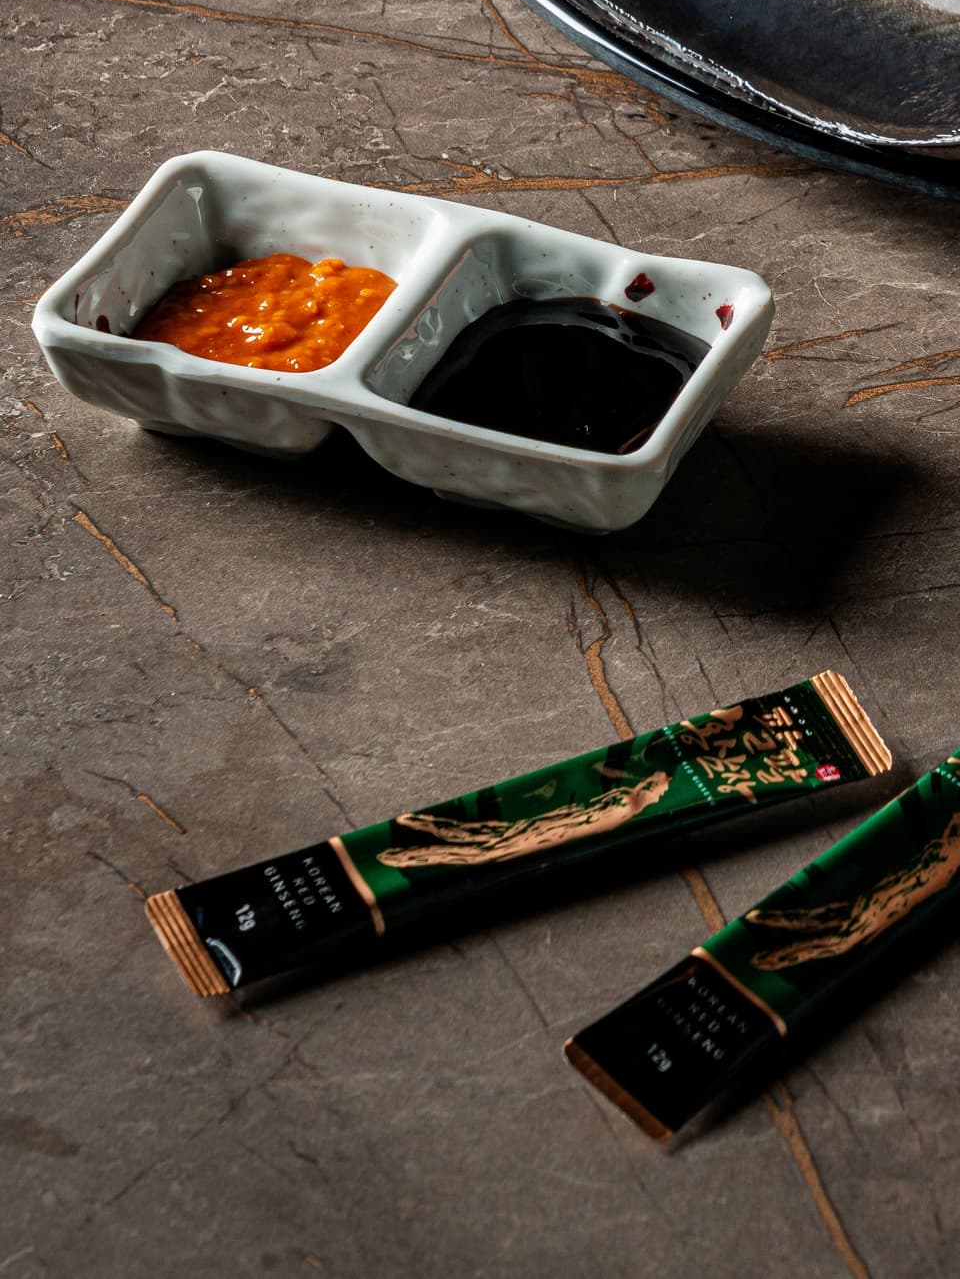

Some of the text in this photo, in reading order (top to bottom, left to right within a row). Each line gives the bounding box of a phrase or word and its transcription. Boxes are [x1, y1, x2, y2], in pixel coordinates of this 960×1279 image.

[263, 865, 307, 931] GINSENG
[292, 876, 316, 906] RED
[302, 856, 342, 914] KOREAN
[235, 903, 256, 932] 12g
